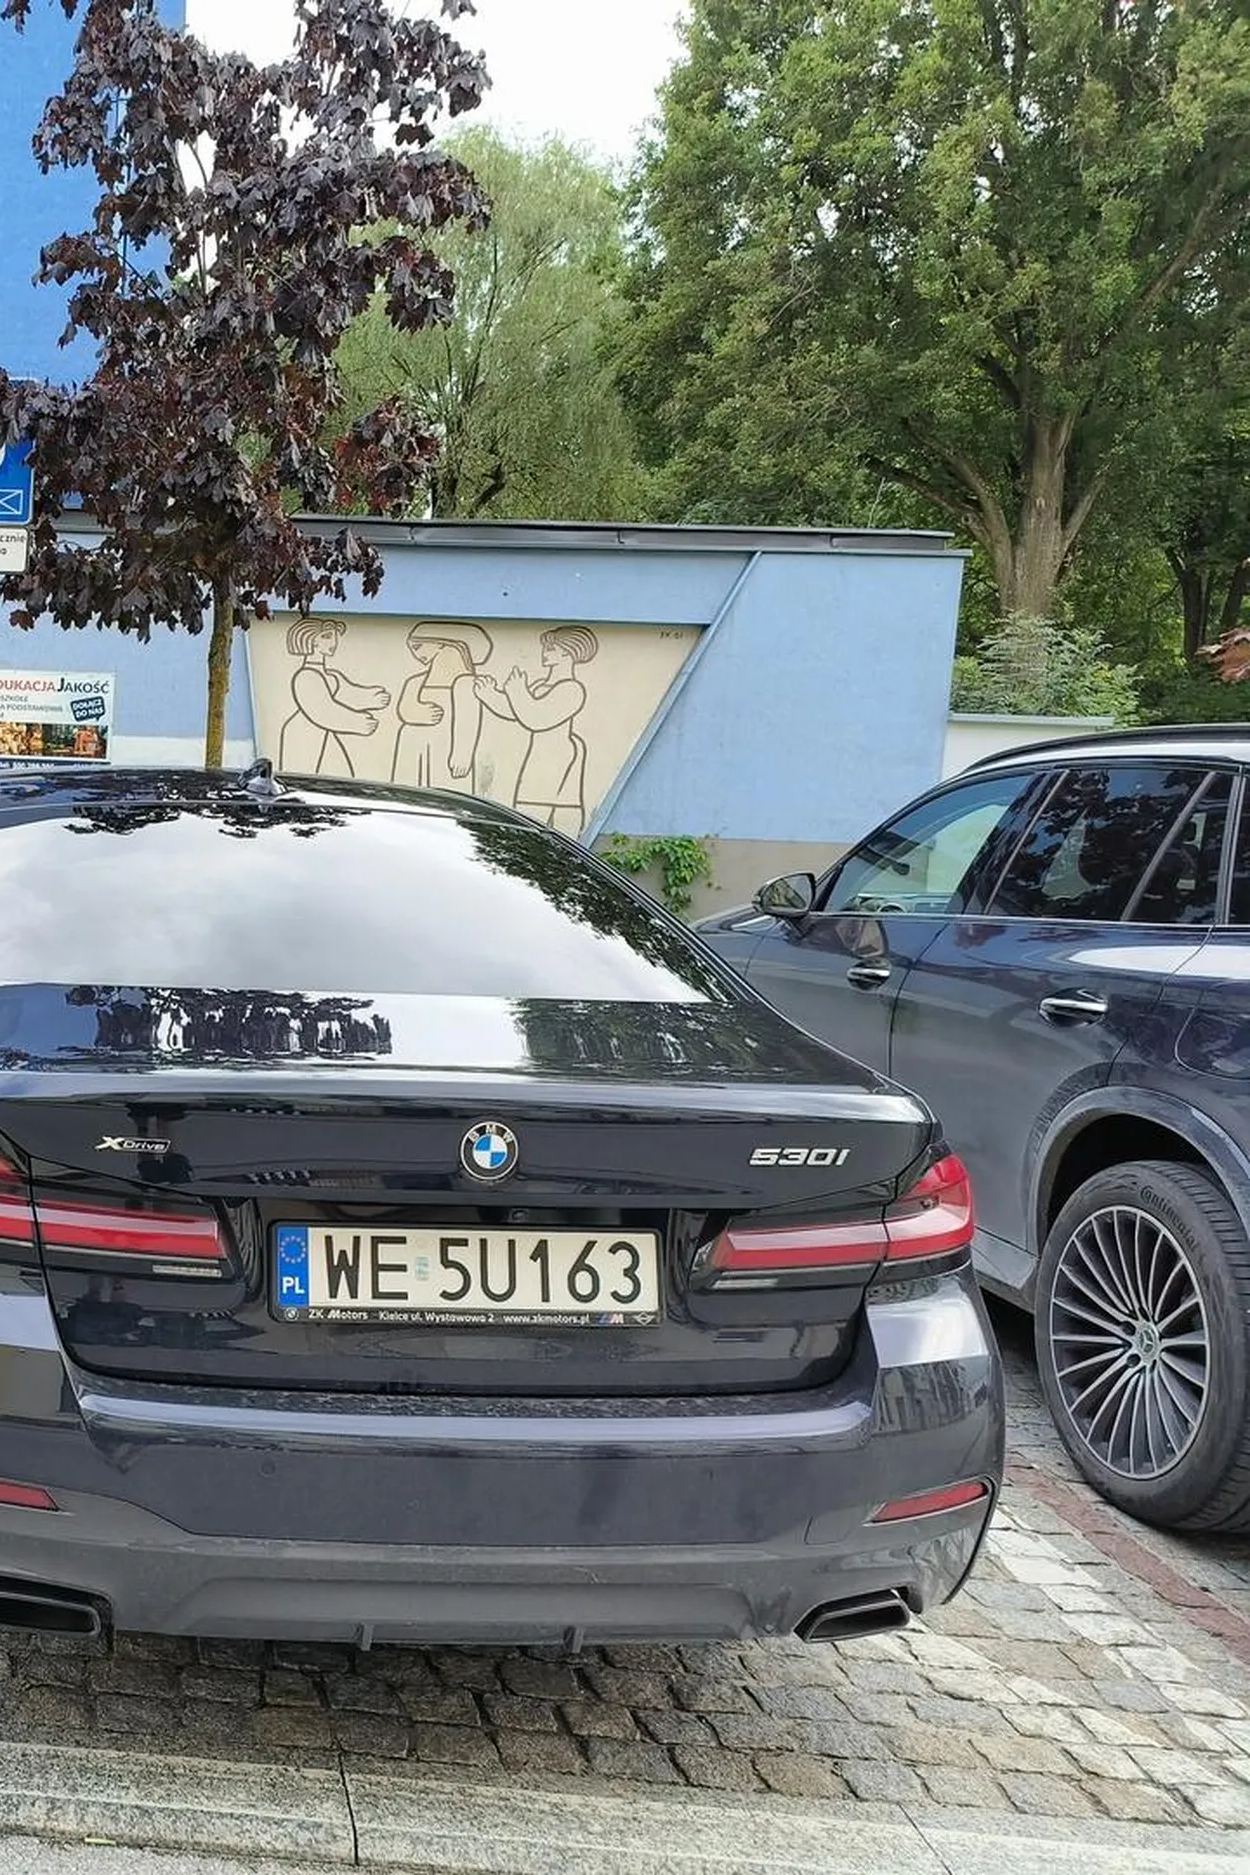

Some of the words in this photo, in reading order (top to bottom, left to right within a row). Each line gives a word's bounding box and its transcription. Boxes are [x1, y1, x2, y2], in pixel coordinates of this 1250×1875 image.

[1140, 1185, 1199, 1252] Continental
[282, 1277, 305, 1294] PL
[324, 1235, 409, 1300] WE
[439, 1237, 642, 1304] 5U163
[327, 1309, 368, 1320] Motors
[378, 1310, 408, 1321] Kielce
[487, 1312, 495, 1322] 2
